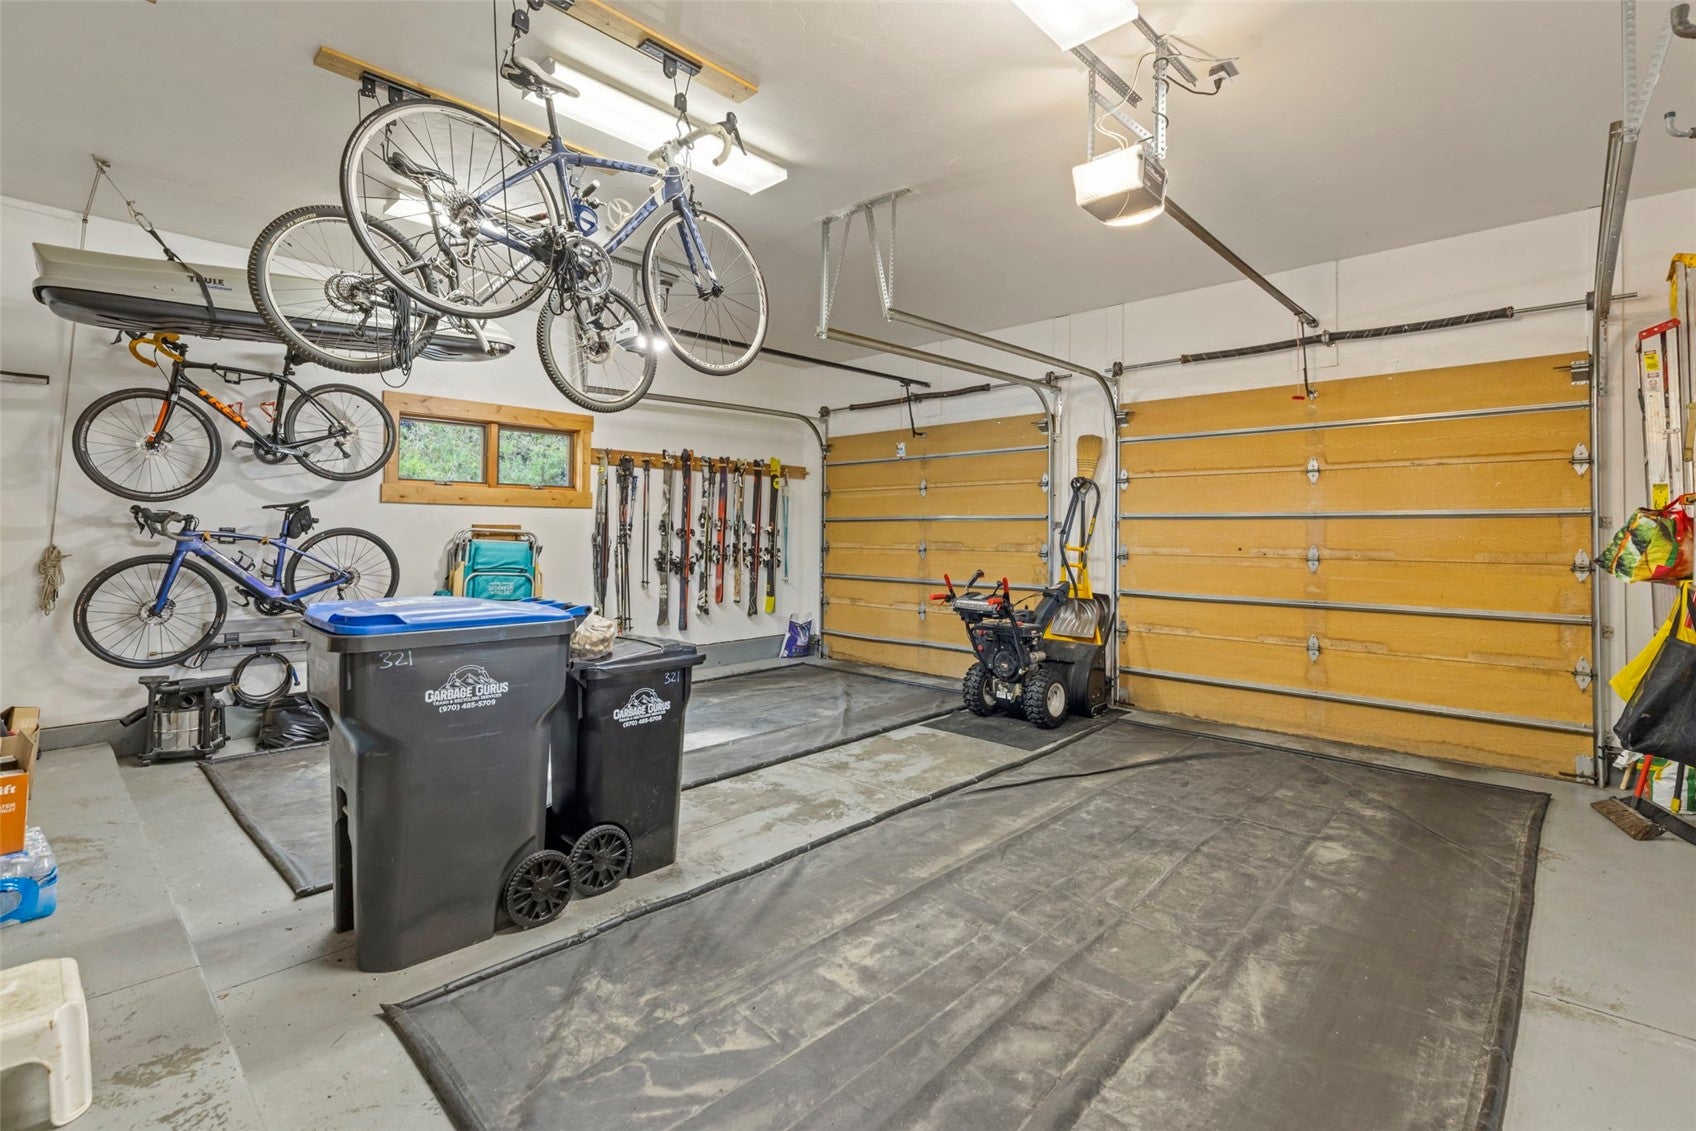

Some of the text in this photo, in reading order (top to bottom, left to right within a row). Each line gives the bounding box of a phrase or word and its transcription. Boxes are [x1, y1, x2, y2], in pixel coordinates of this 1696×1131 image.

[198, 389, 248, 429] TREK
[379, 651, 413, 669] 321
[664, 670, 680, 684] 321
[425, 682, 509, 703] GARBAGE GURUS
[439, 699, 496, 713] (970) 485-5709
